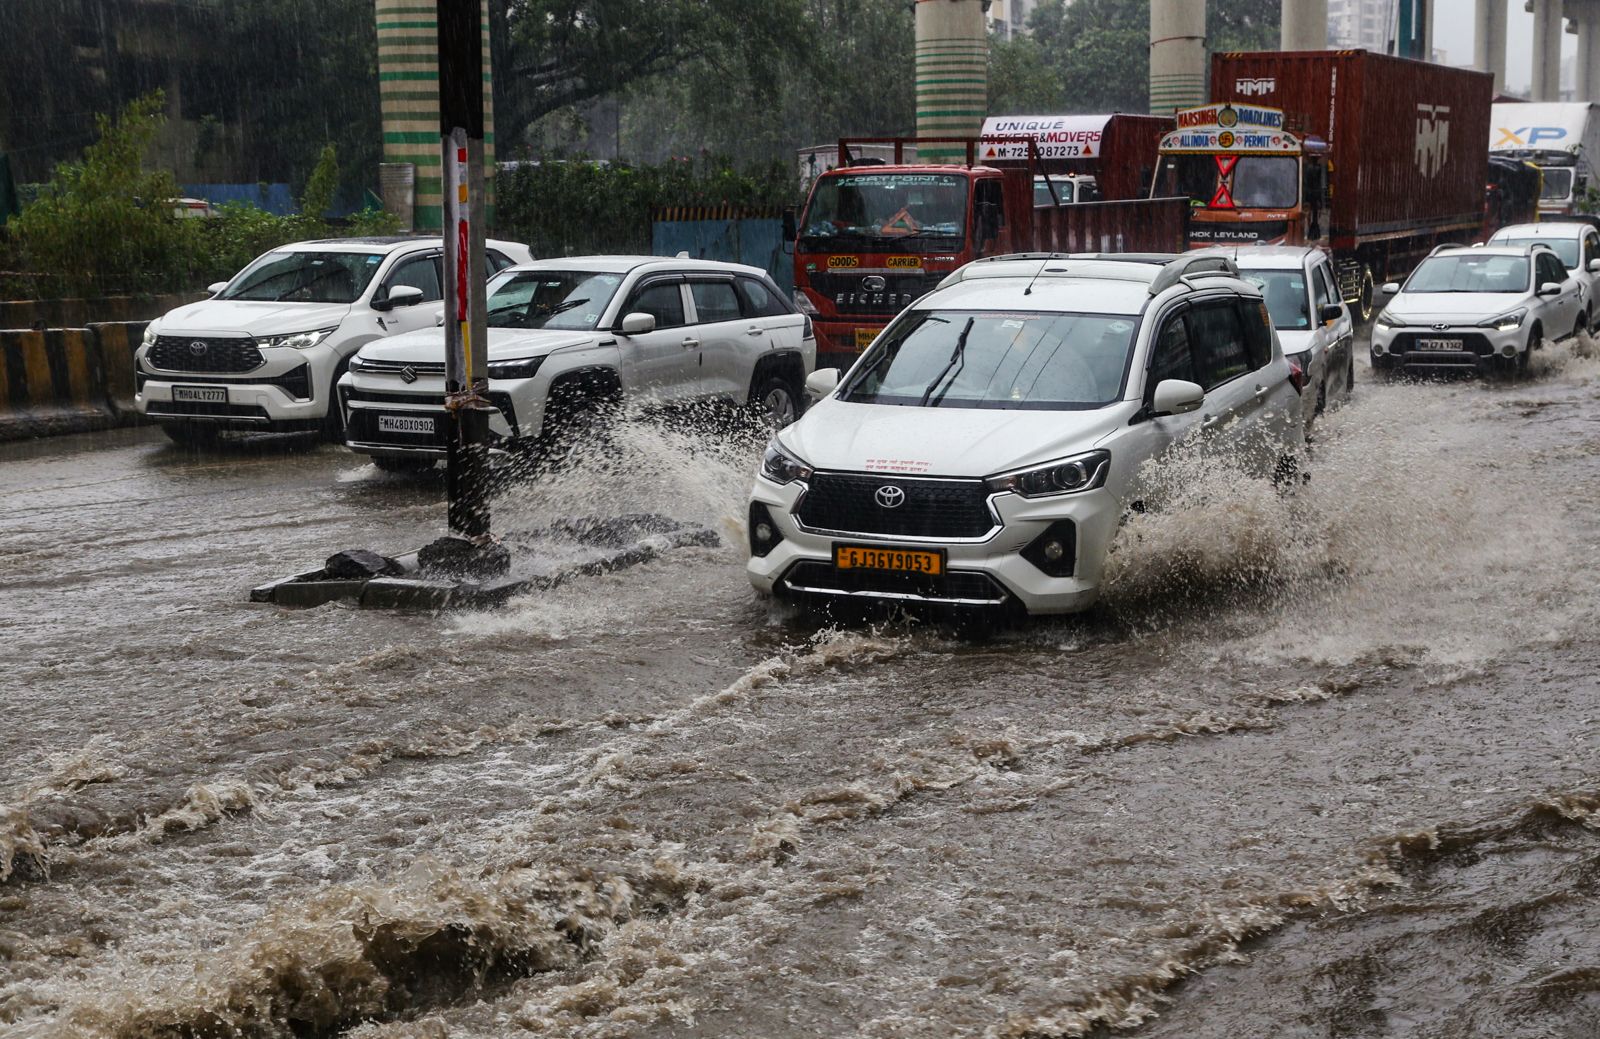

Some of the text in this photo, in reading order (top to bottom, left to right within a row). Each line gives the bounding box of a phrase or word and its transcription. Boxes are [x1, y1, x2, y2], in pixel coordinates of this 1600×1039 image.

[1236, 78, 1275, 96] HMM
[1239, 108, 1282, 127] ROADLINES
[995, 121, 1065, 131] UNIQUE
[1244, 135, 1271, 148] PERMIT
[1414, 103, 1450, 178] HMM
[1493, 127, 1567, 146] XP
[997, 145, 1079, 158] M-725087273
[1214, 231, 1258, 239] LEYLAND
[828, 256, 858, 267] GOODS
[887, 256, 919, 267] CARRIER
[836, 293, 912, 305] EICHER
[384, 418, 434, 431] MH48DX0902
